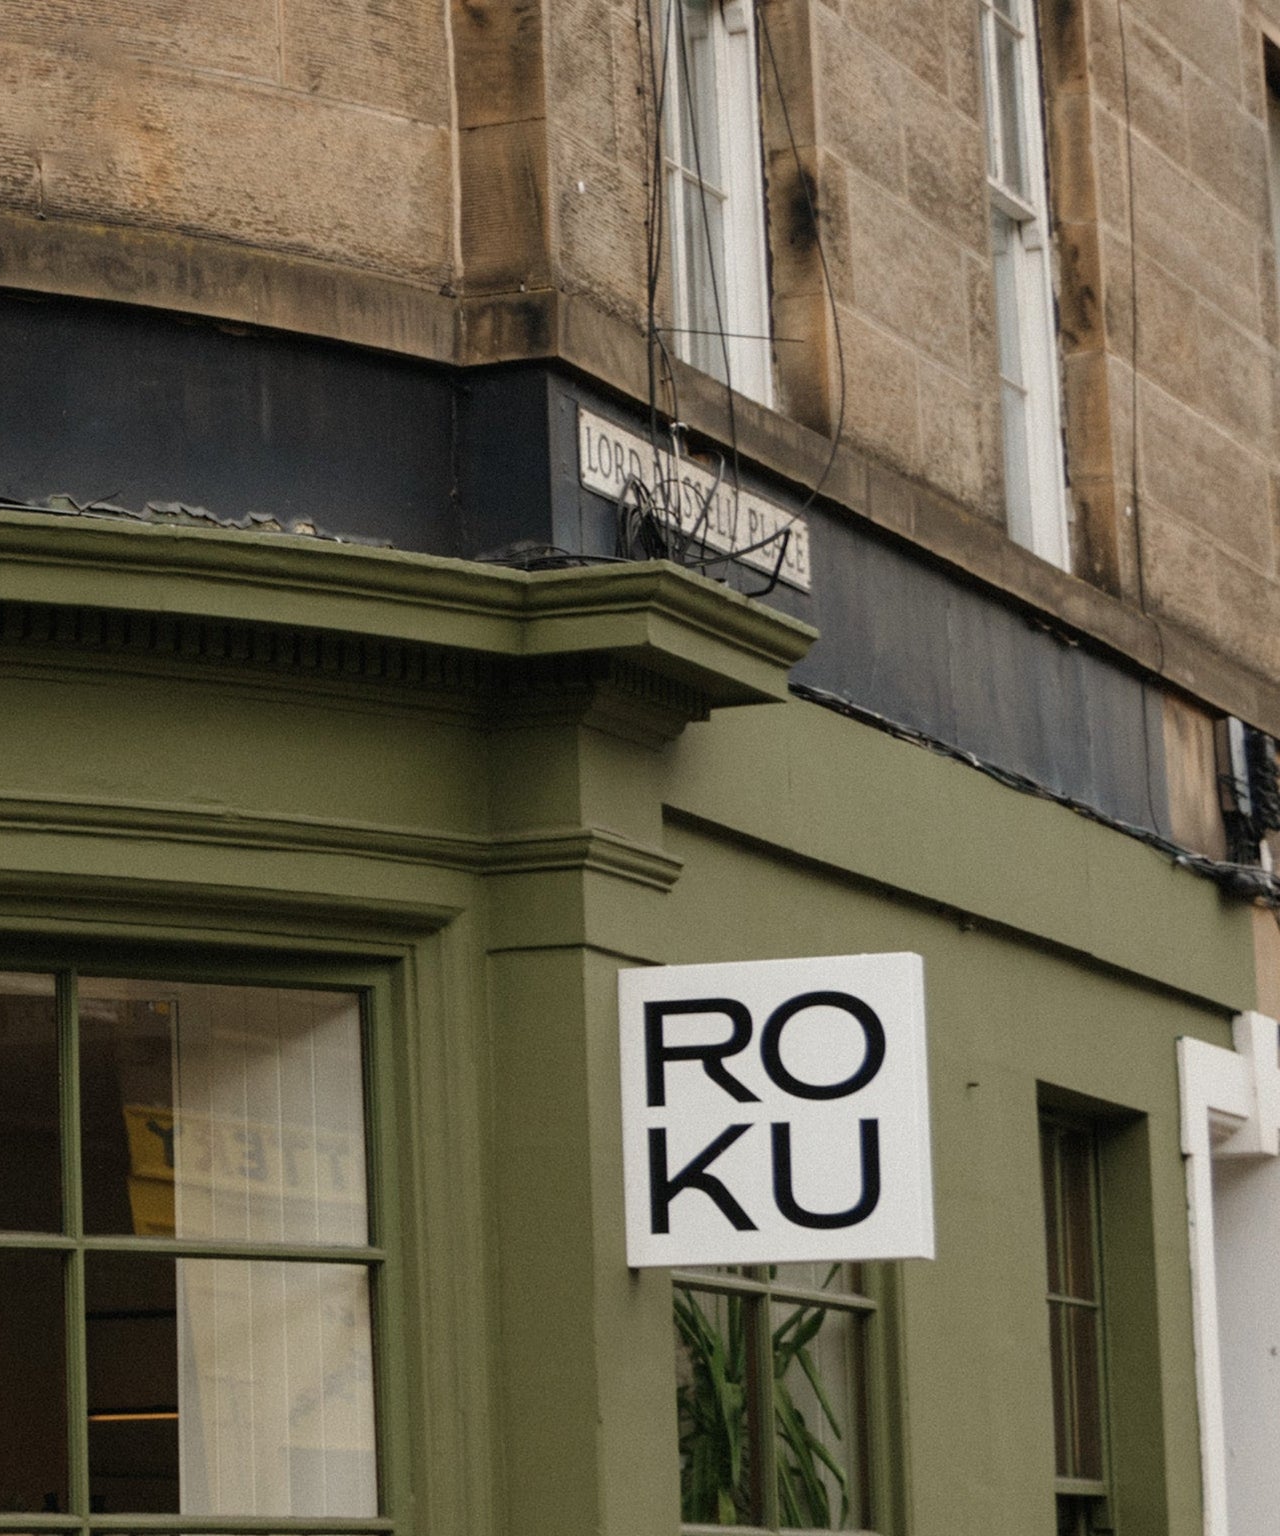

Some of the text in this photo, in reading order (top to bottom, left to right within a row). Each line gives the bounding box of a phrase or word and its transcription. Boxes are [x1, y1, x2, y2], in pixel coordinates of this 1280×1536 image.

[585, 426, 643, 488] LORD
[748, 508, 806, 574] PLACE
[643, 990, 886, 1107] RO
[647, 1118, 881, 1234] KU
